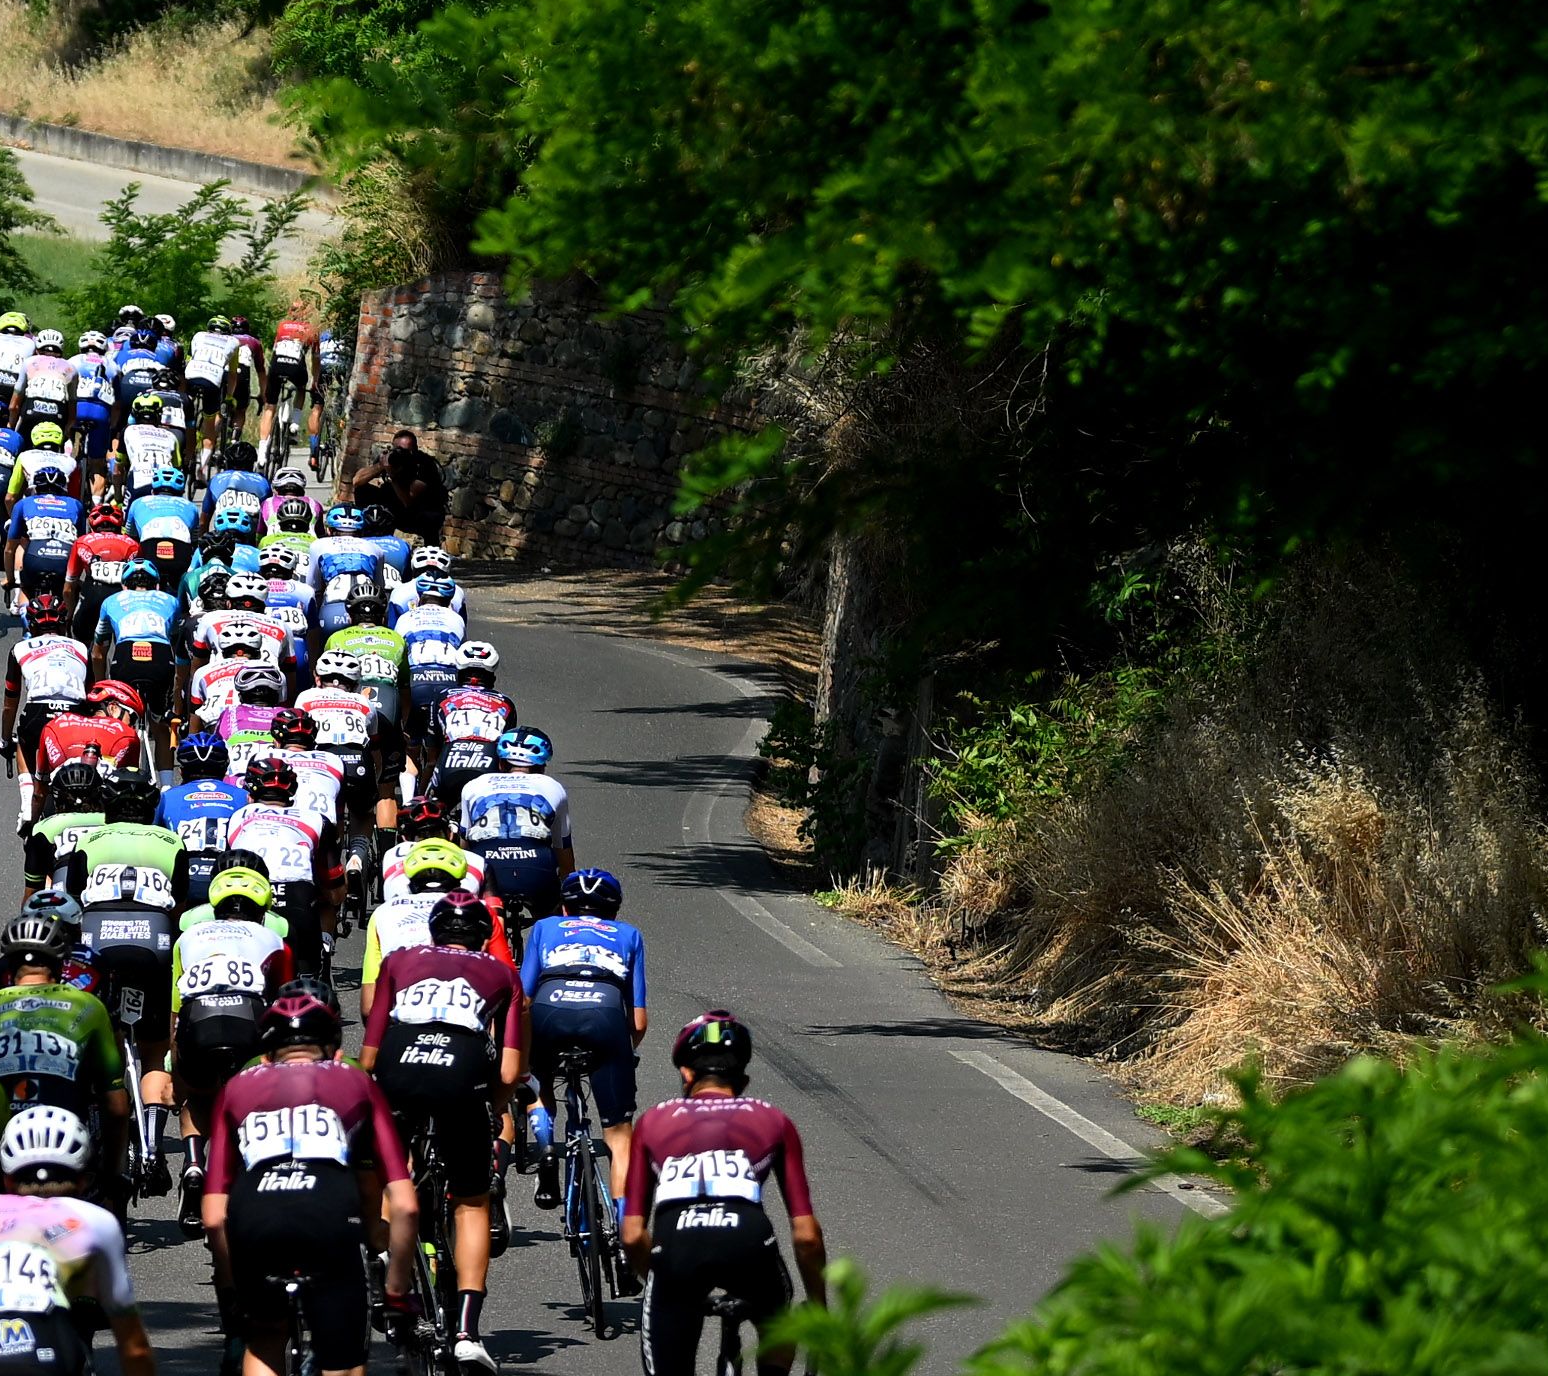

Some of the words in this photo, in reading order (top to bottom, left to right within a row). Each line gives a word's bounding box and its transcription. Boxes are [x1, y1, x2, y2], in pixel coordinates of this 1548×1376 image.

[29, 518, 51, 530] 126
[94, 562, 109, 578] 76
[419, 641, 427, 655] 7
[442, 641, 450, 656] 7
[32, 671, 49, 691] 21
[66, 671, 81, 691] 21
[412, 673, 456, 682] FANTINI
[48, 703, 70, 711] UAE
[54, 713, 125, 733] ARKEA
[345, 715, 365, 734] 96
[451, 711, 471, 728] 41
[482, 714, 501, 732] 41
[450, 742, 484, 753] selle
[445, 751, 494, 770] italia
[308, 791, 329, 813] 23
[529, 808, 541, 828] 6
[280, 847, 304, 868] 22
[485, 849, 537, 860] FANTINI
[99, 931, 151, 940] DIABETES
[187, 962, 213, 989] 85
[227, 960, 254, 987] 85
[126, 987, 144, 1016] 164
[402, 983, 441, 1007] 157
[563, 991, 606, 1000] SELF
[415, 1033, 451, 1048] selle
[399, 1045, 455, 1067] italia
[243, 1111, 285, 1149] 151
[667, 1157, 699, 1182] 52
[257, 1171, 317, 1192] italia
[676, 1208, 739, 1231] italia
